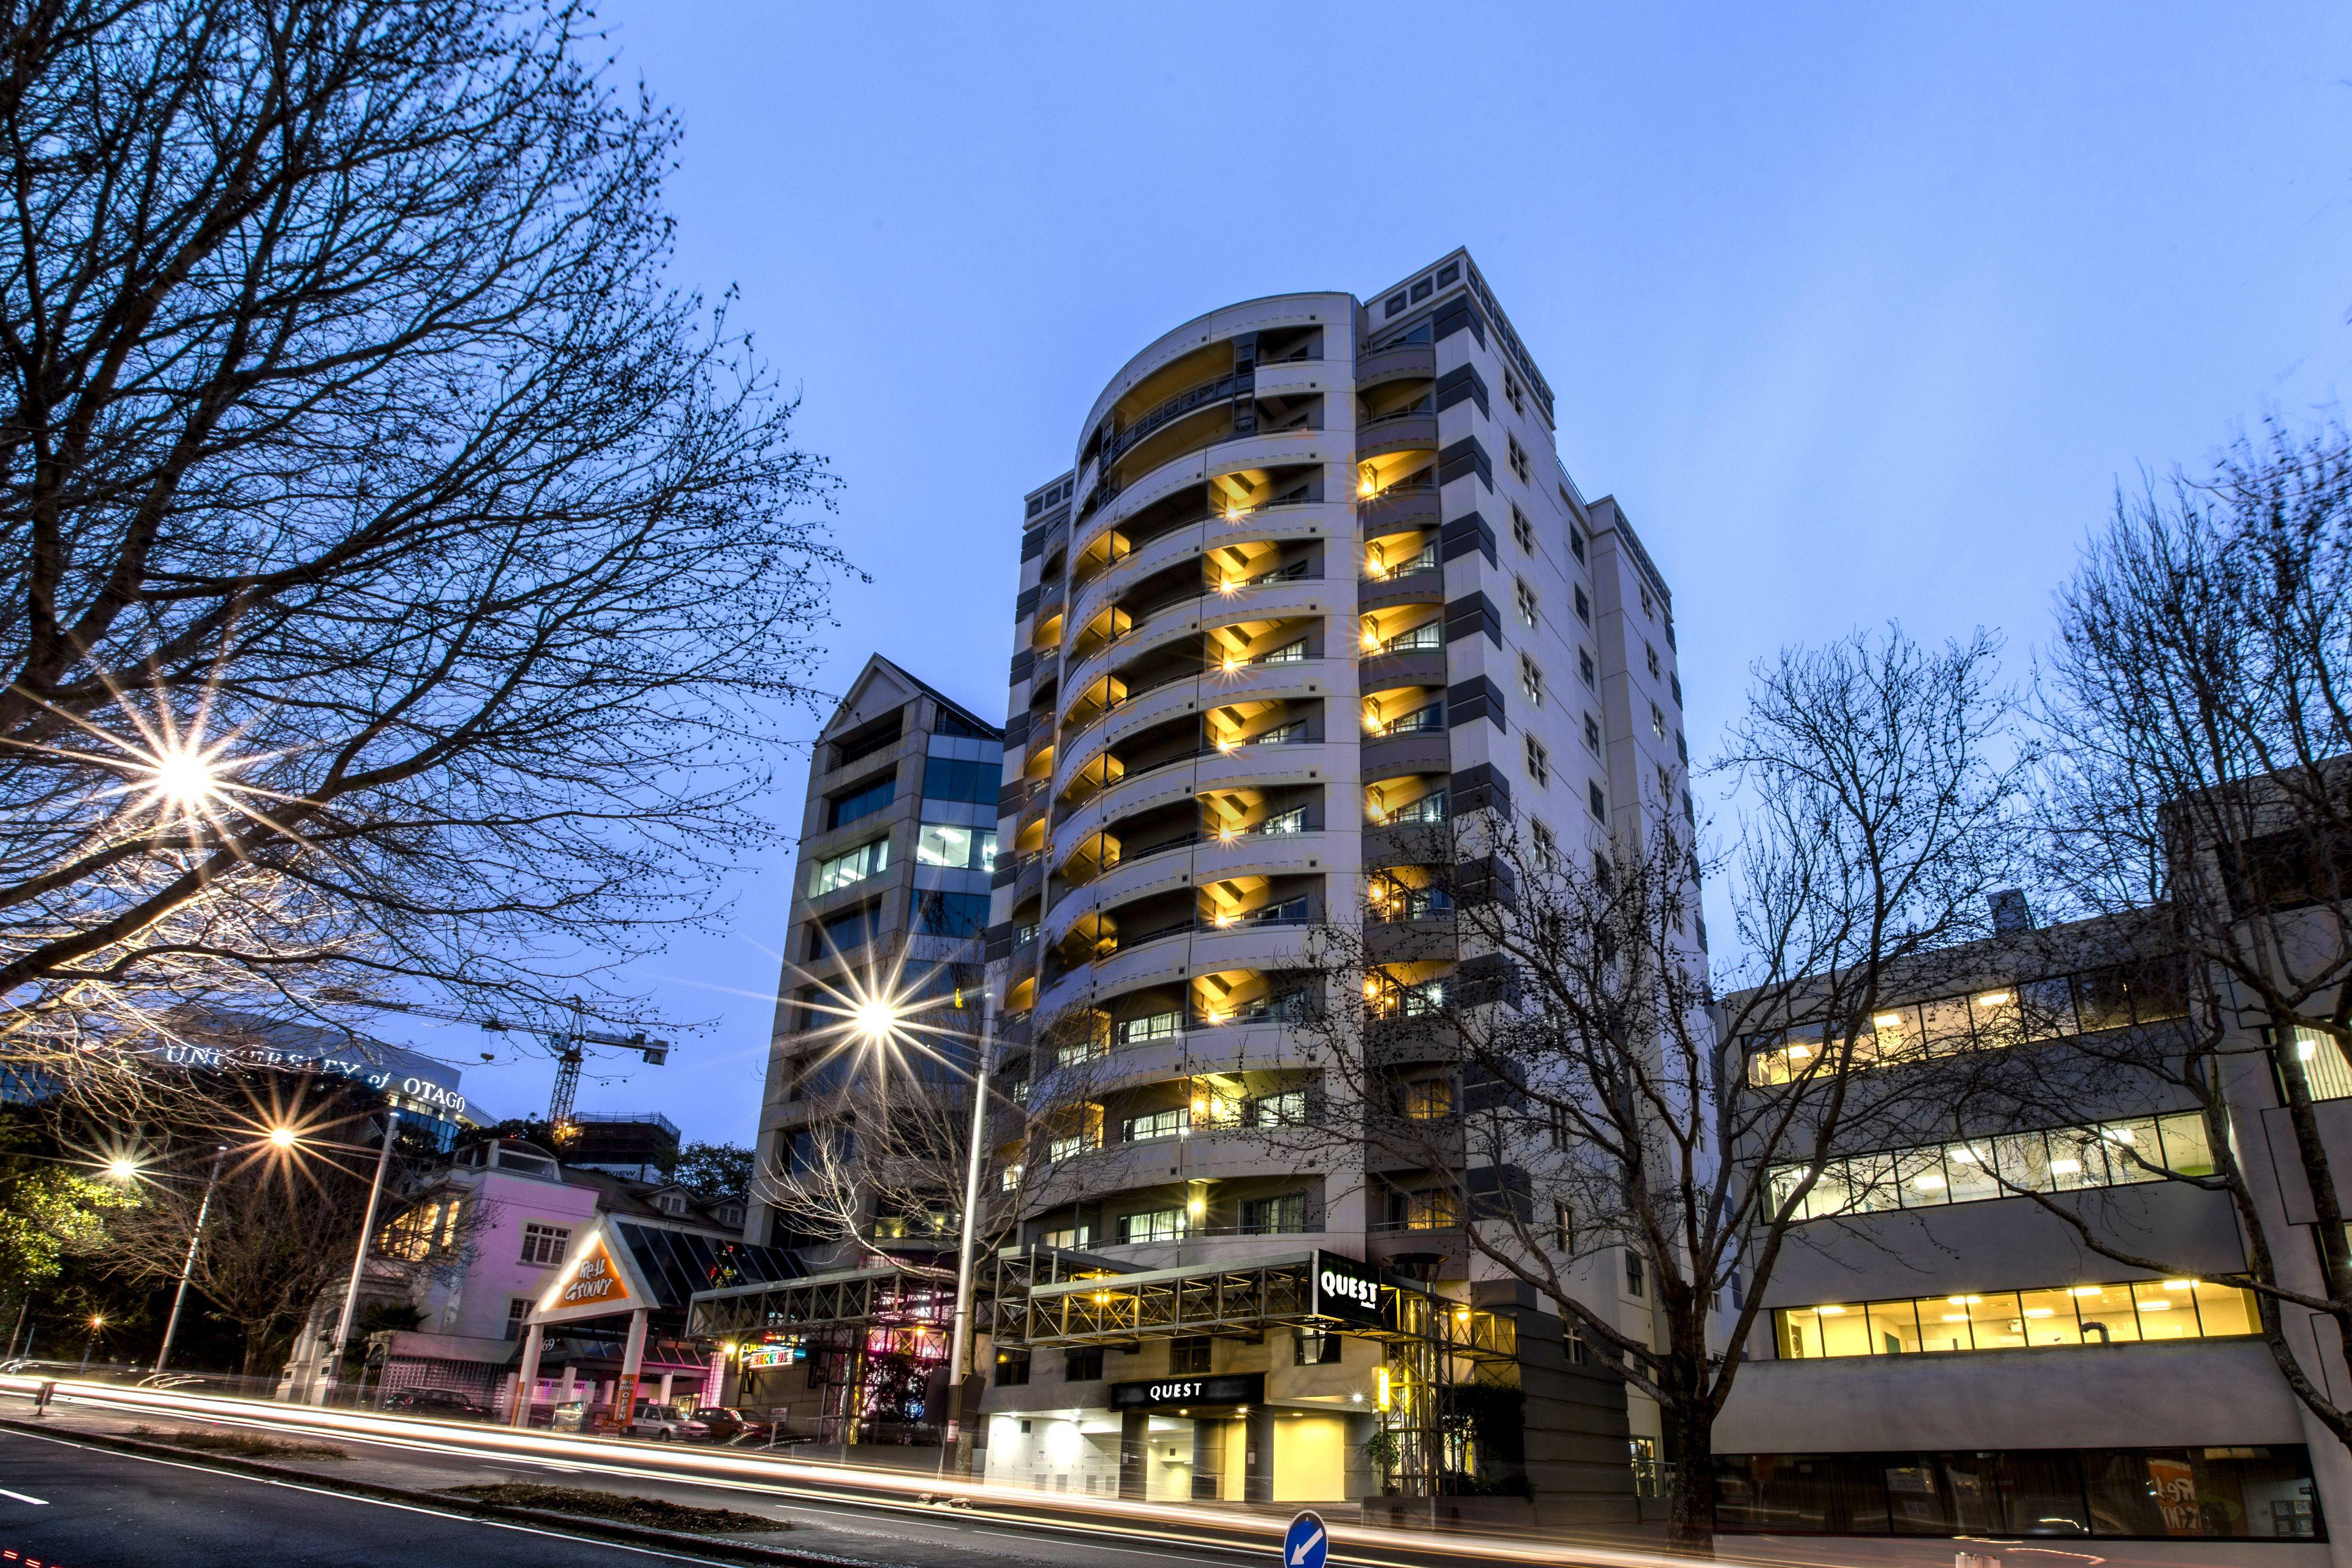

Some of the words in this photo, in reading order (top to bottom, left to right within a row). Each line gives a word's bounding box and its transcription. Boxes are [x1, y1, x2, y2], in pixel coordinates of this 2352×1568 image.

[369, 1072, 393, 1089] of
[403, 1077, 466, 1113] OTAGO
[1321, 1271, 1378, 1302] QUEST
[541, 1338, 556, 1351] 69
[1150, 1382, 1202, 1401] QUEST
[619, 1392, 630, 1420] OPEN
